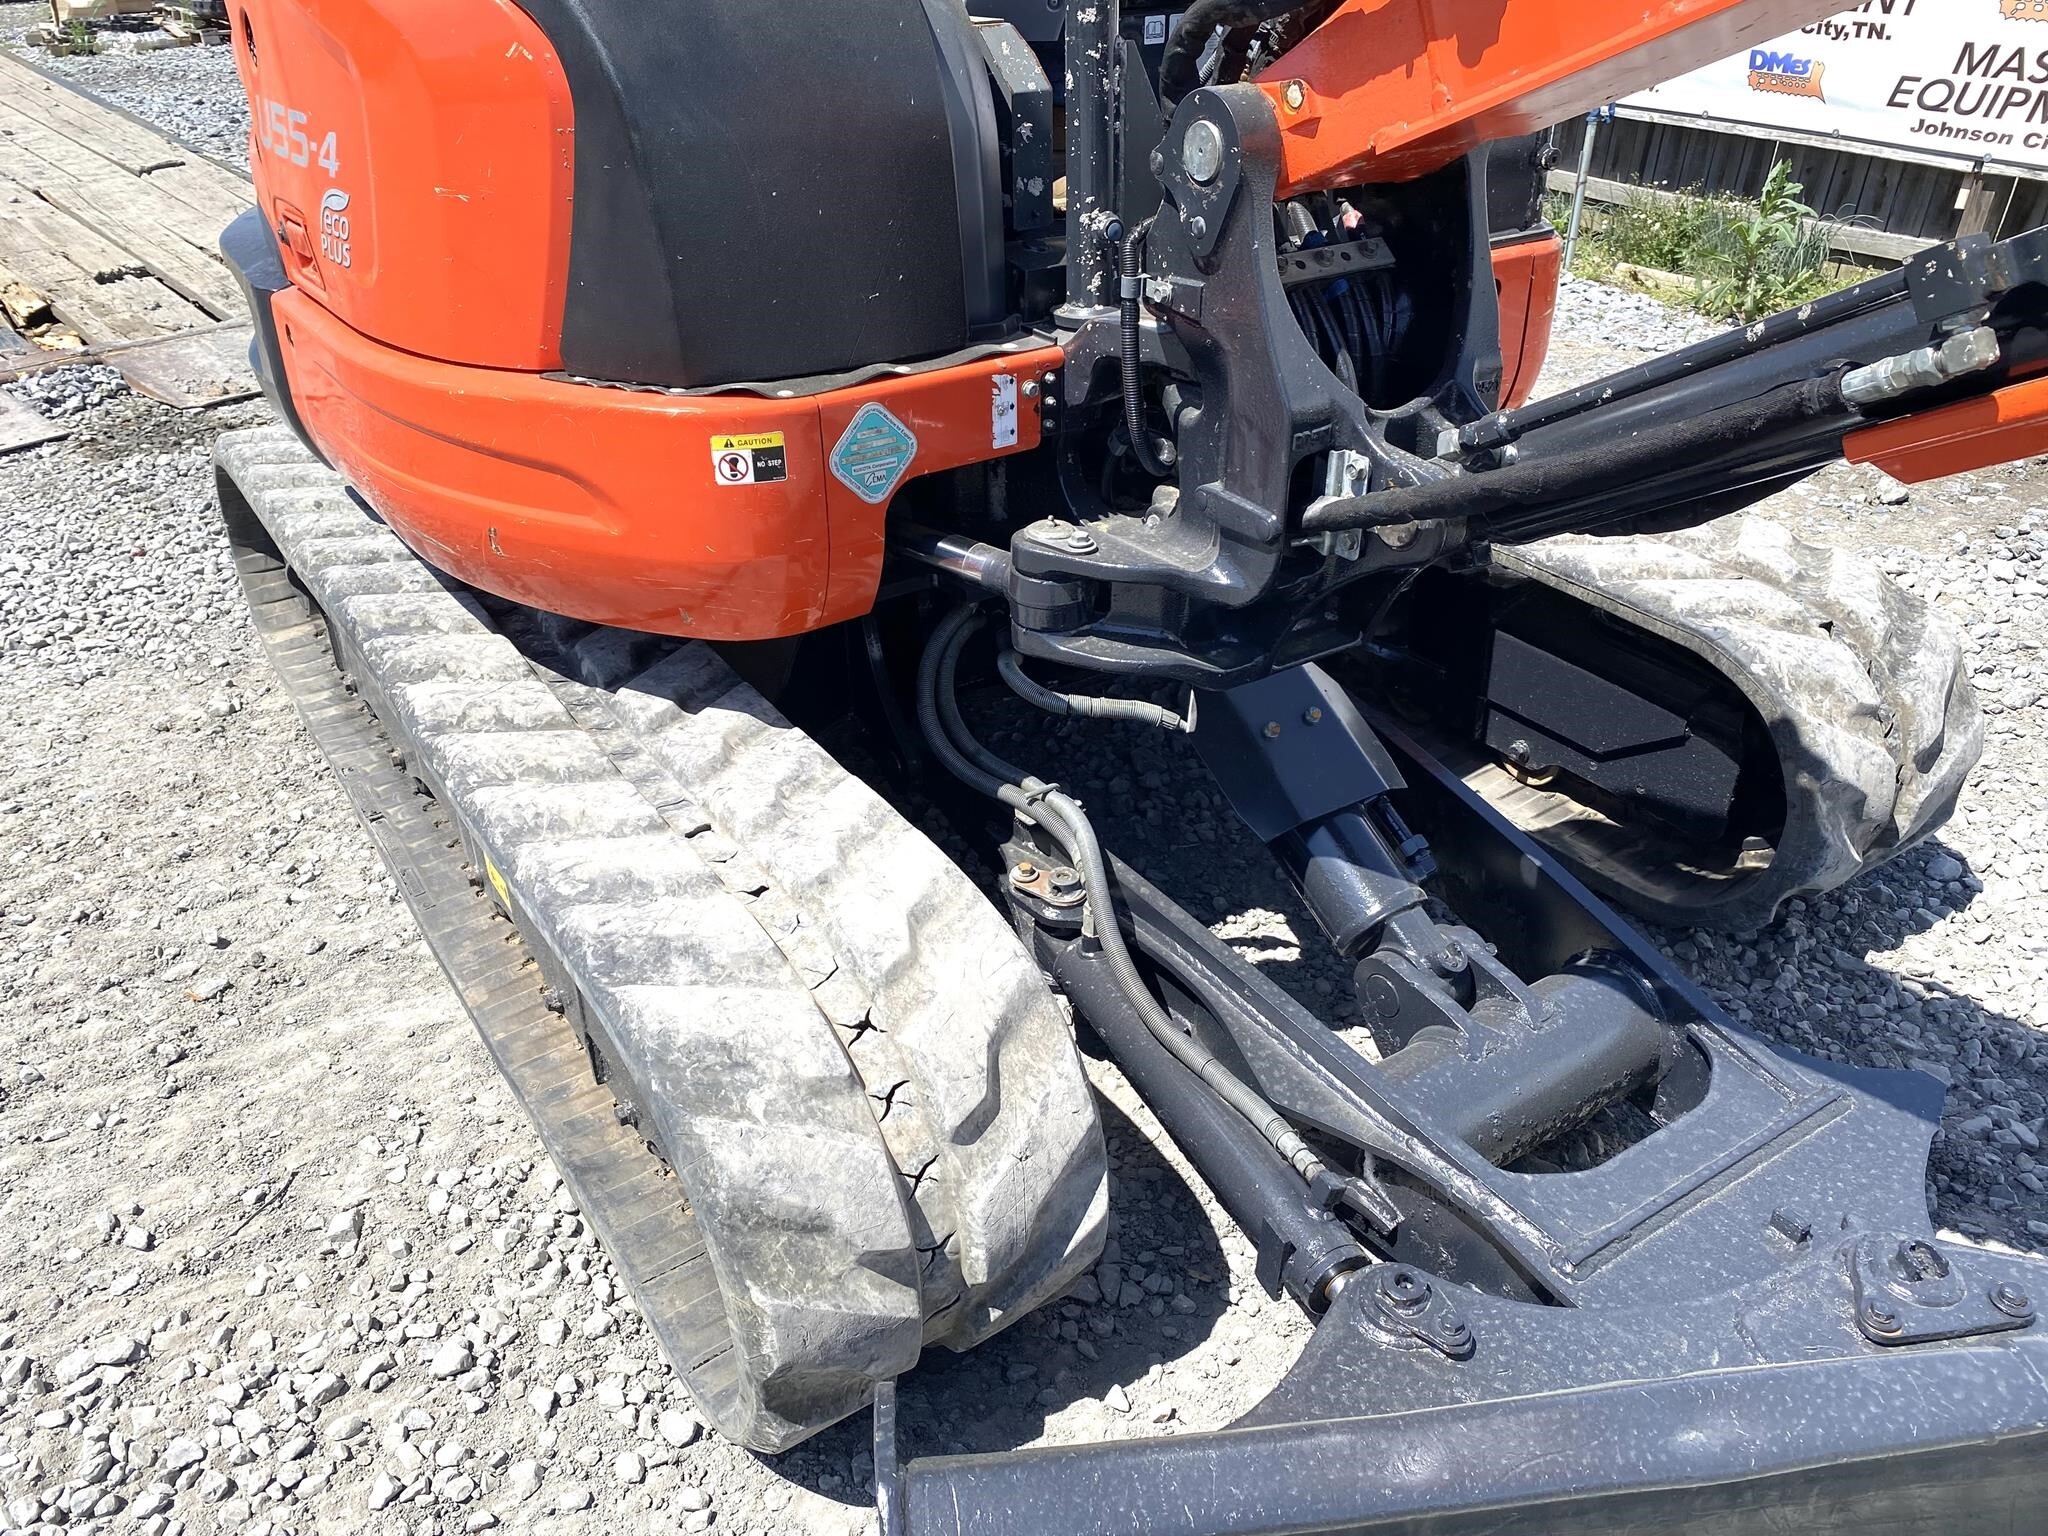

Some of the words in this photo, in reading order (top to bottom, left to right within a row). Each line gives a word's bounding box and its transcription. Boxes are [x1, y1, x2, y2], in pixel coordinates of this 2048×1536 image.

[1952, 41, 2048, 84] MAS
[1910, 118, 2014, 145] Johnson
[321, 233, 351, 268] PLUS
[737, 438, 772, 446] CAUTION
[768, 459, 782, 467] STEP
